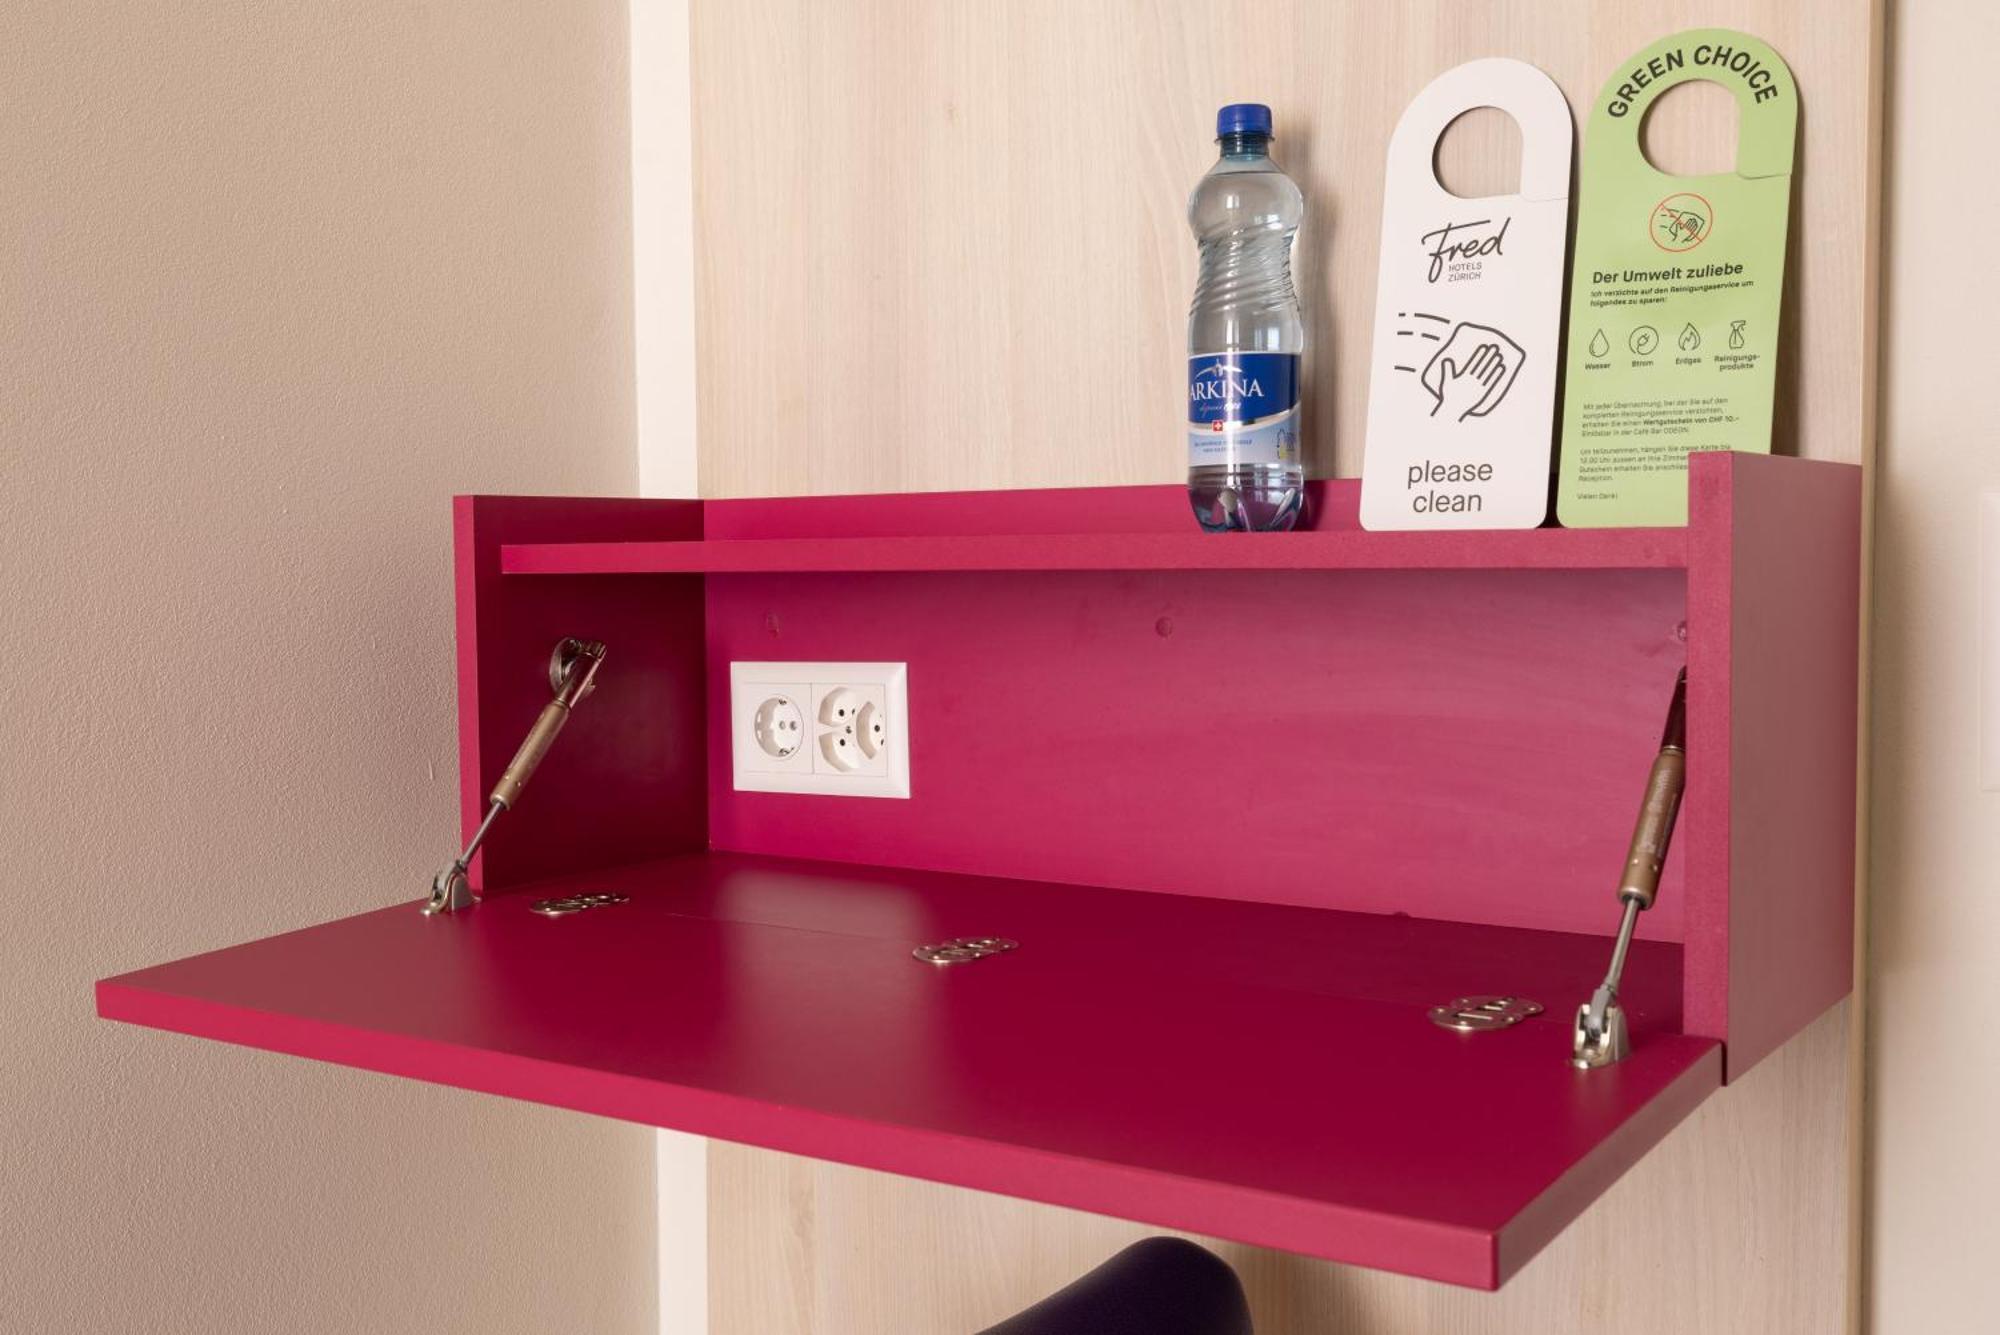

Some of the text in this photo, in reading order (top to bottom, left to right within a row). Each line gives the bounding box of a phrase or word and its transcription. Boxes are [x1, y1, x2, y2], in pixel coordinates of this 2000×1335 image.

[1608, 45, 1778, 118] GREEN CHOICE
[1421, 217, 1511, 283] Fred
[1448, 271, 1482, 282] ZÜRICH
[1449, 262, 1482, 272] HOTELS
[1593, 262, 1744, 284] Der Umwelt zuliebe
[1591, 279, 1754, 298] Ich verzichte auf den Reinigungsservice um
[1590, 298, 1627, 308] folgendes
[1584, 362, 1611, 370] Wasser
[1675, 357, 1702, 366] Erdgas
[1714, 353, 1760, 364] Reinigungs-
[1719, 362, 1754, 372] produkte
[1190, 378, 1265, 401] ARKINA
[1643, 418, 1693, 426] Wertgutschein
[1408, 460, 1493, 490] please
[1413, 490, 1482, 513] clean
